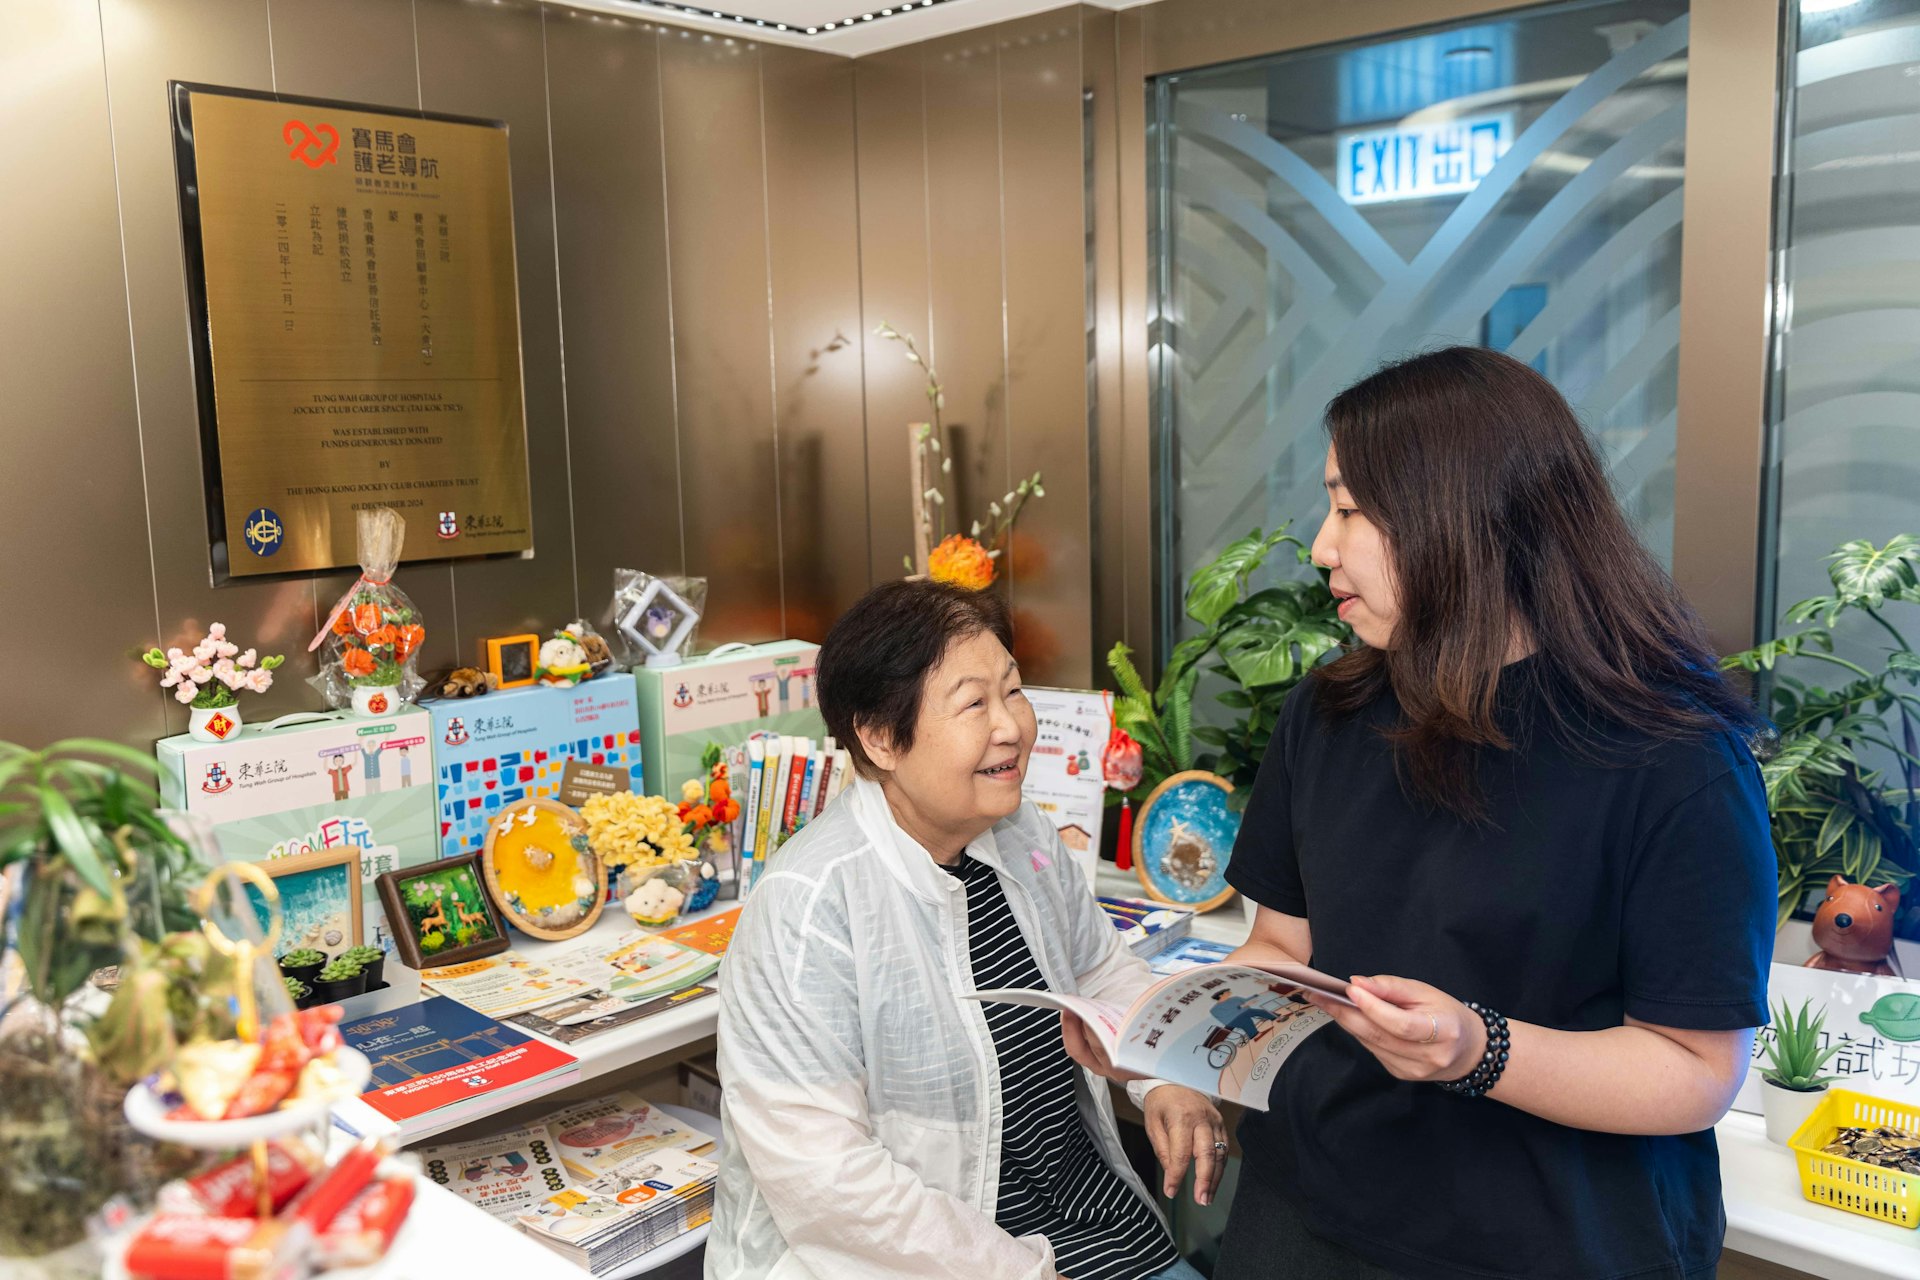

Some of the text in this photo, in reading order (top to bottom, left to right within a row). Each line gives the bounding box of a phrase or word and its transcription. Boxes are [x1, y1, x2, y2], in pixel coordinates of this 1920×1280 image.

[352, 128, 416, 154] 賽馬會
[354, 150, 439, 179] 護老導航
[1351, 121, 1500, 196] EXIT 出口
[313, 394, 337, 403] TUNG
[339, 394, 358, 403] WAH
[359, 394, 388, 402] GROUP
[400, 392, 442, 402] HOSPITALS
[292, 406, 326, 415] JOCKEY
[327, 406, 351, 414] CLUB
[352, 405, 380, 414] CARER
[382, 405, 405, 413] SPACE
[333, 425, 429, 437] WAS ESTABLISHED WITH
[321, 436, 443, 448] FUNDS GENEROUSLY DONATED
[379, 460, 391, 468] BY
[286, 478, 480, 496] THE HONG KONG JOCKEY CLUB CHARITIES TRUST
[213, 718, 228, 733] 財
[474, 716, 514, 734] 東華三院
[238, 759, 288, 780] 東華三院
[267, 777, 284, 785] Group
[356, 1024, 432, 1049] 心在一起
[365, 1042, 394, 1053] Together
[446, 1068, 486, 1083] Anniversary
